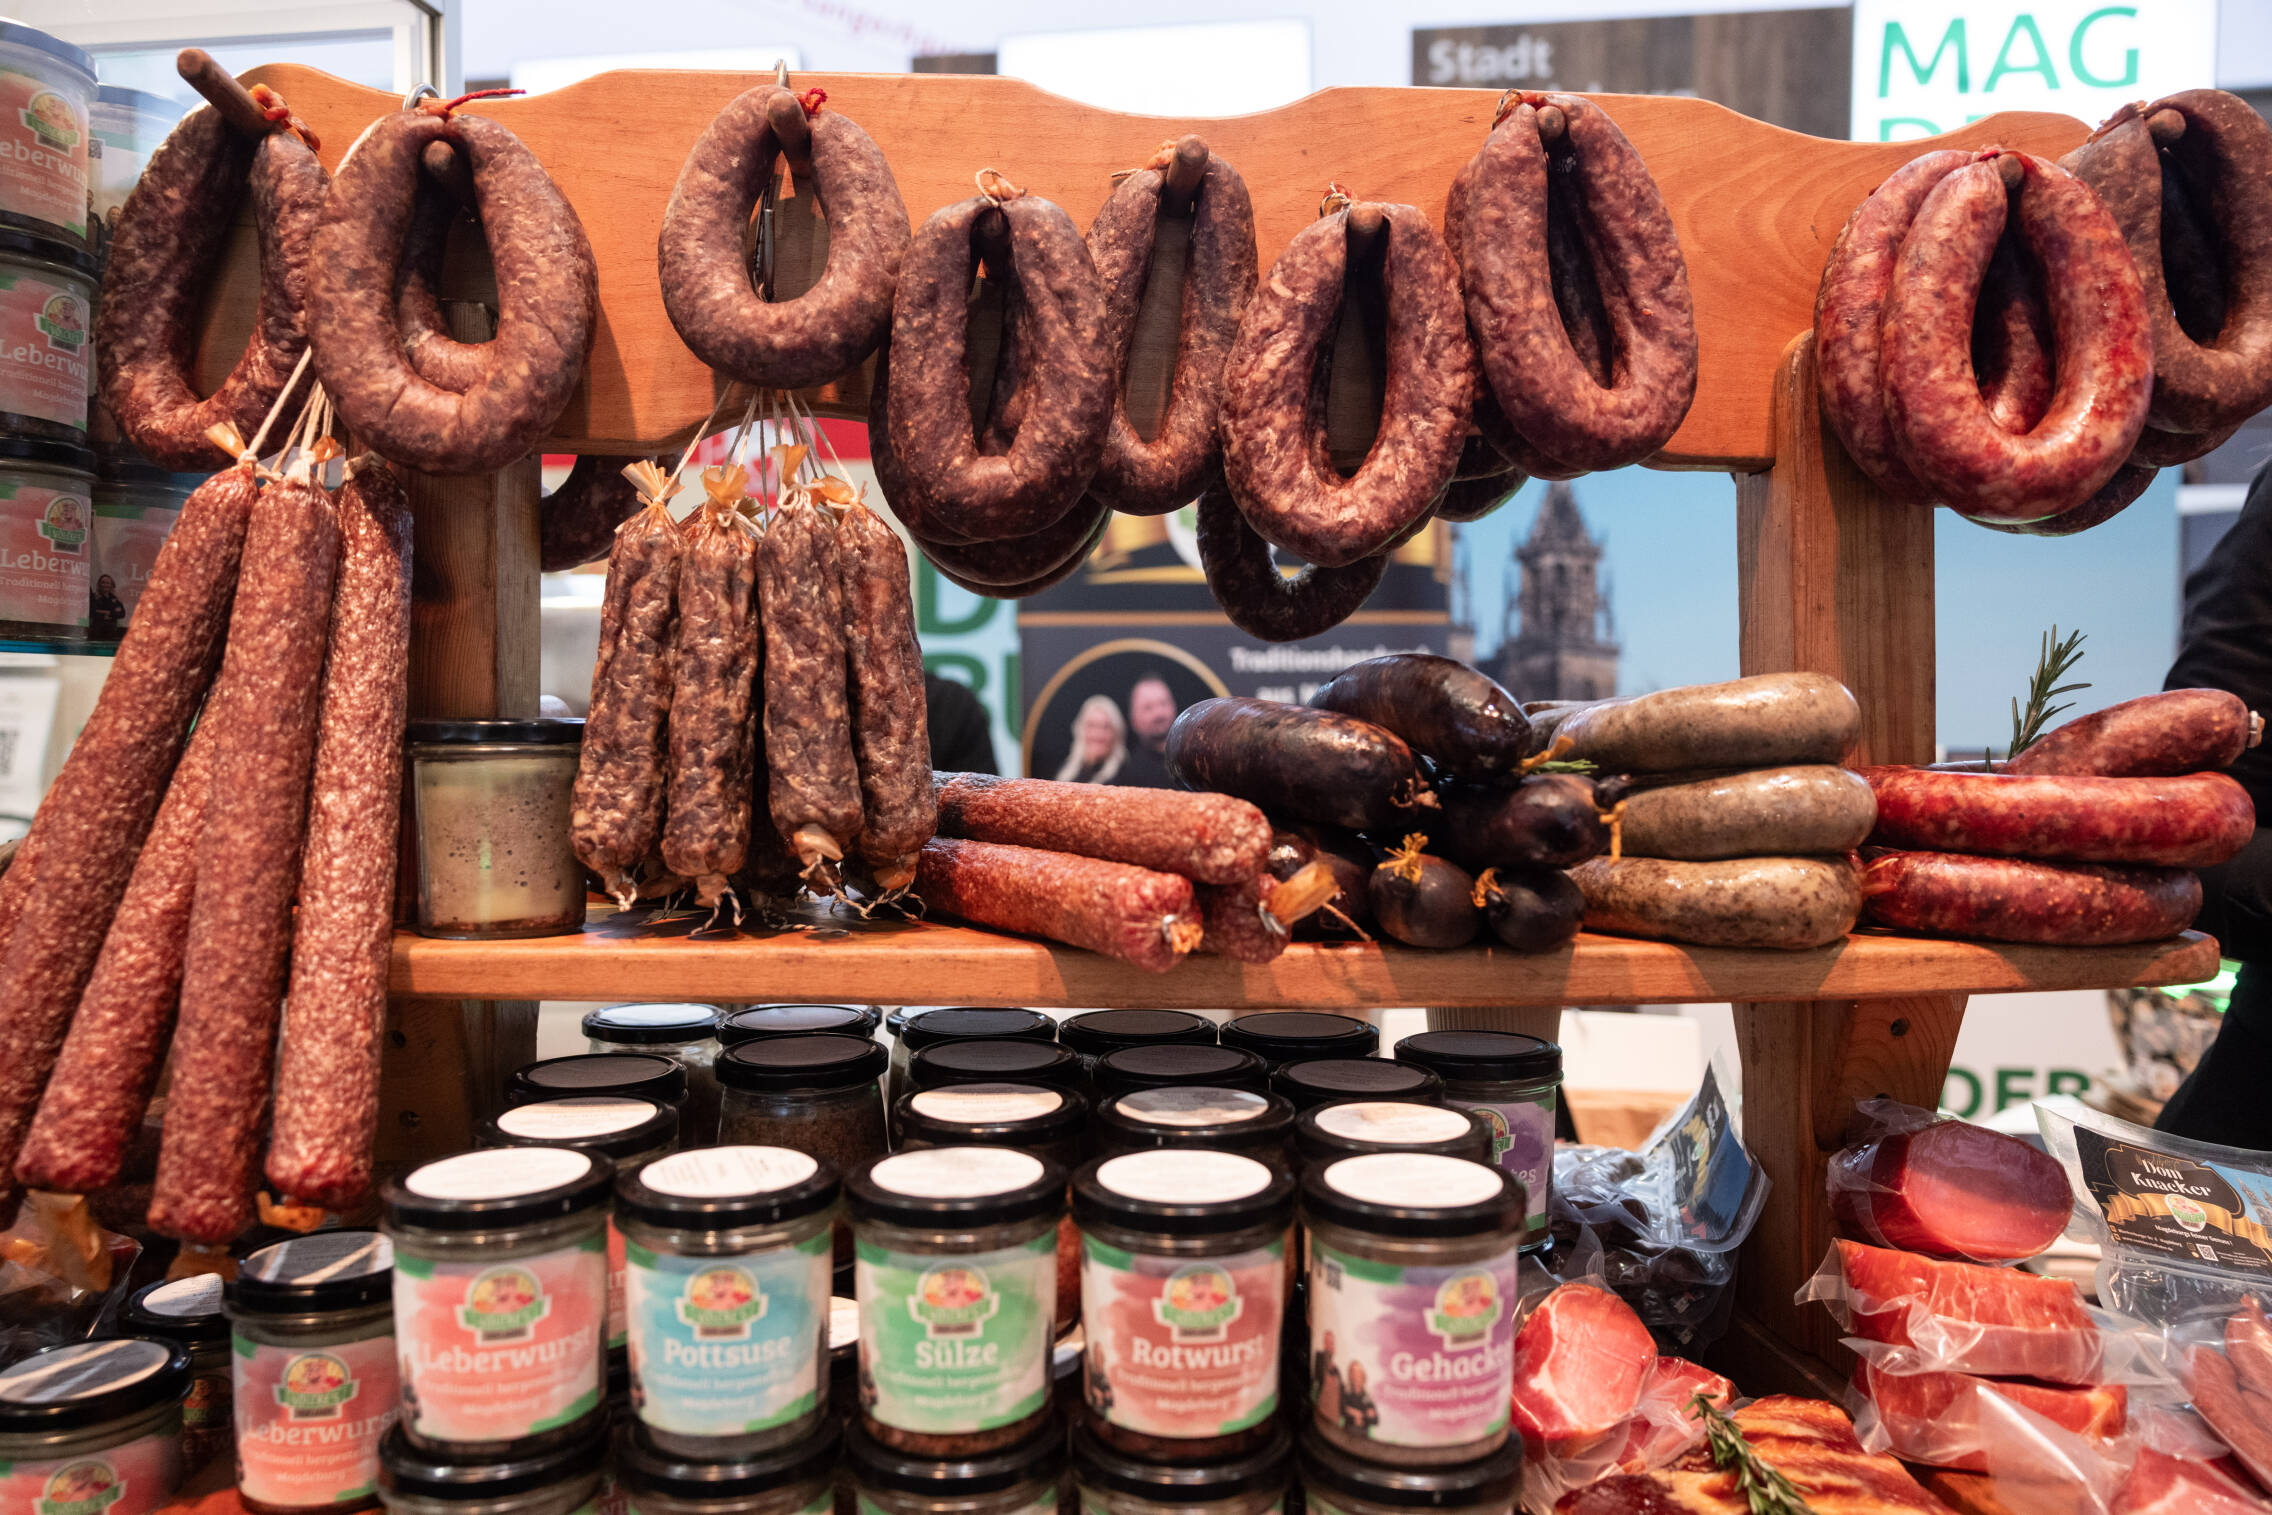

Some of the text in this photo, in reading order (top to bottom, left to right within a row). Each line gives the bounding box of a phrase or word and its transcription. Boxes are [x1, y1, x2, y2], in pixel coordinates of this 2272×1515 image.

[1428, 36, 1554, 83] Stadt
[1878, 7, 2140, 98] MAG
[2130, 1171, 2212, 1197] Knacker
[2140, 1158, 2185, 1181] Dom
[420, 1326, 591, 1373] Leberwurst
[664, 1336, 792, 1368] Pottsuse
[914, 1340, 999, 1369] Sülze
[1132, 1334, 1264, 1369] Rotwurst
